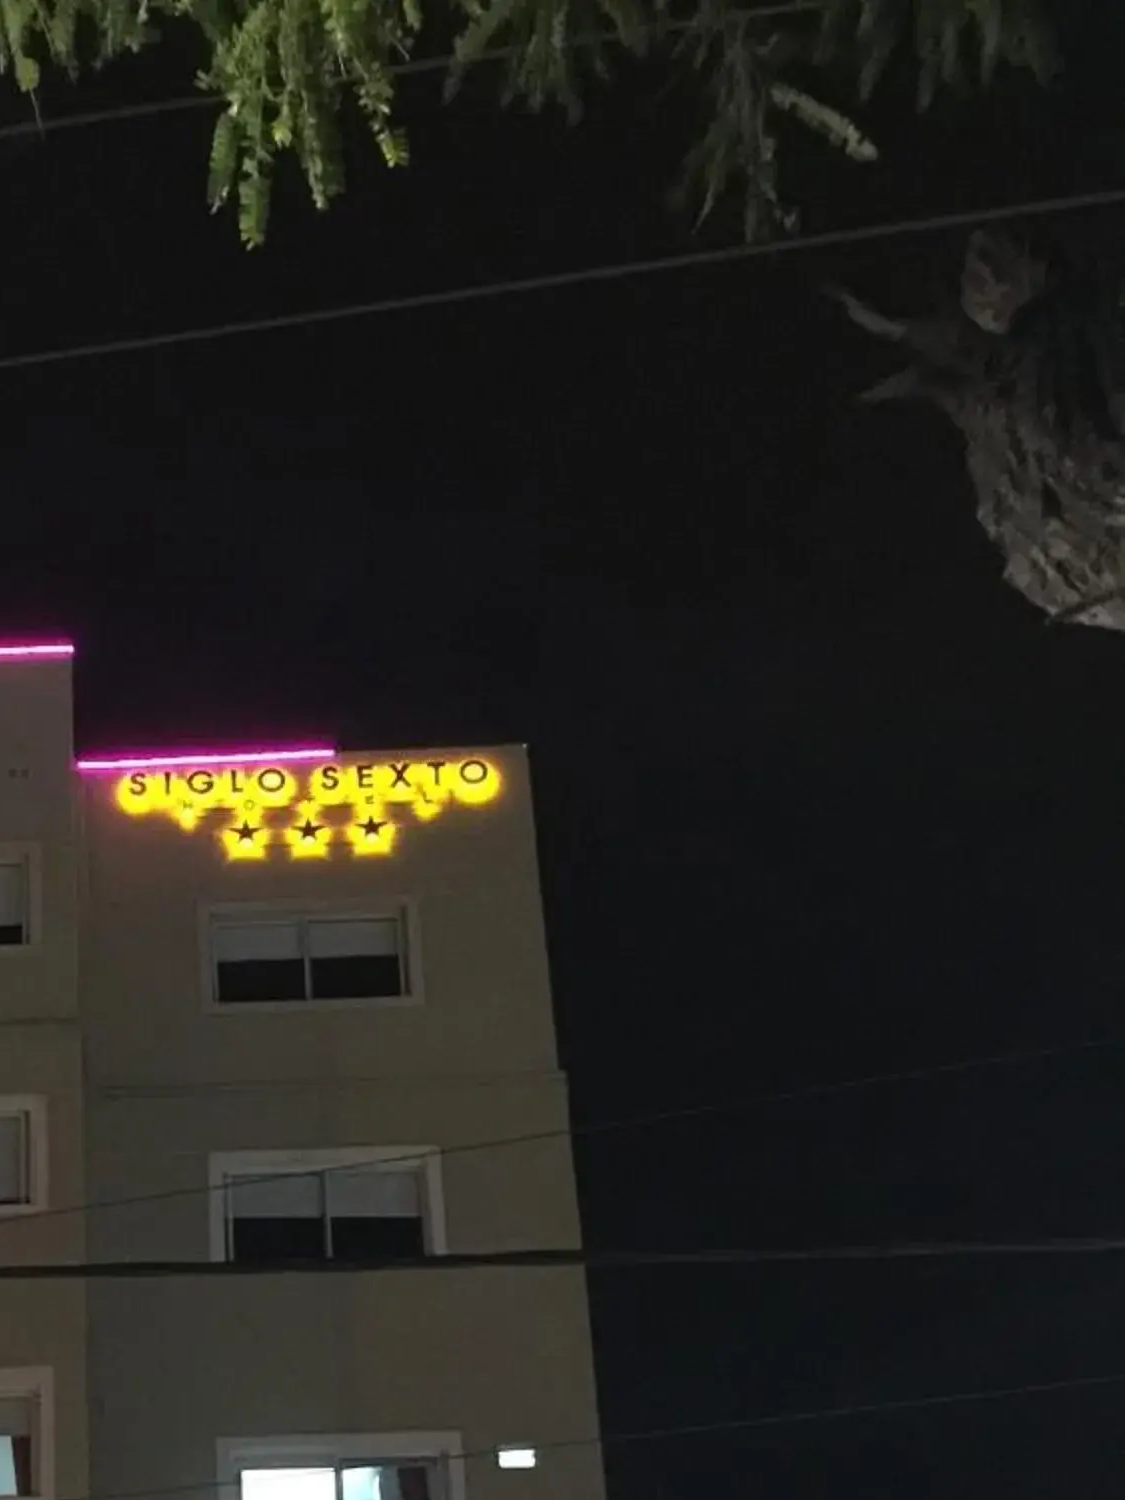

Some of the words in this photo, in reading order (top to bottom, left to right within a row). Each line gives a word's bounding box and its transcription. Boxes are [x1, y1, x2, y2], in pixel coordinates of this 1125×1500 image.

[128, 767, 286, 798] SIGLO
[320, 759, 489, 791] SEXTO
[182, 791, 433, 812] HOTEL
